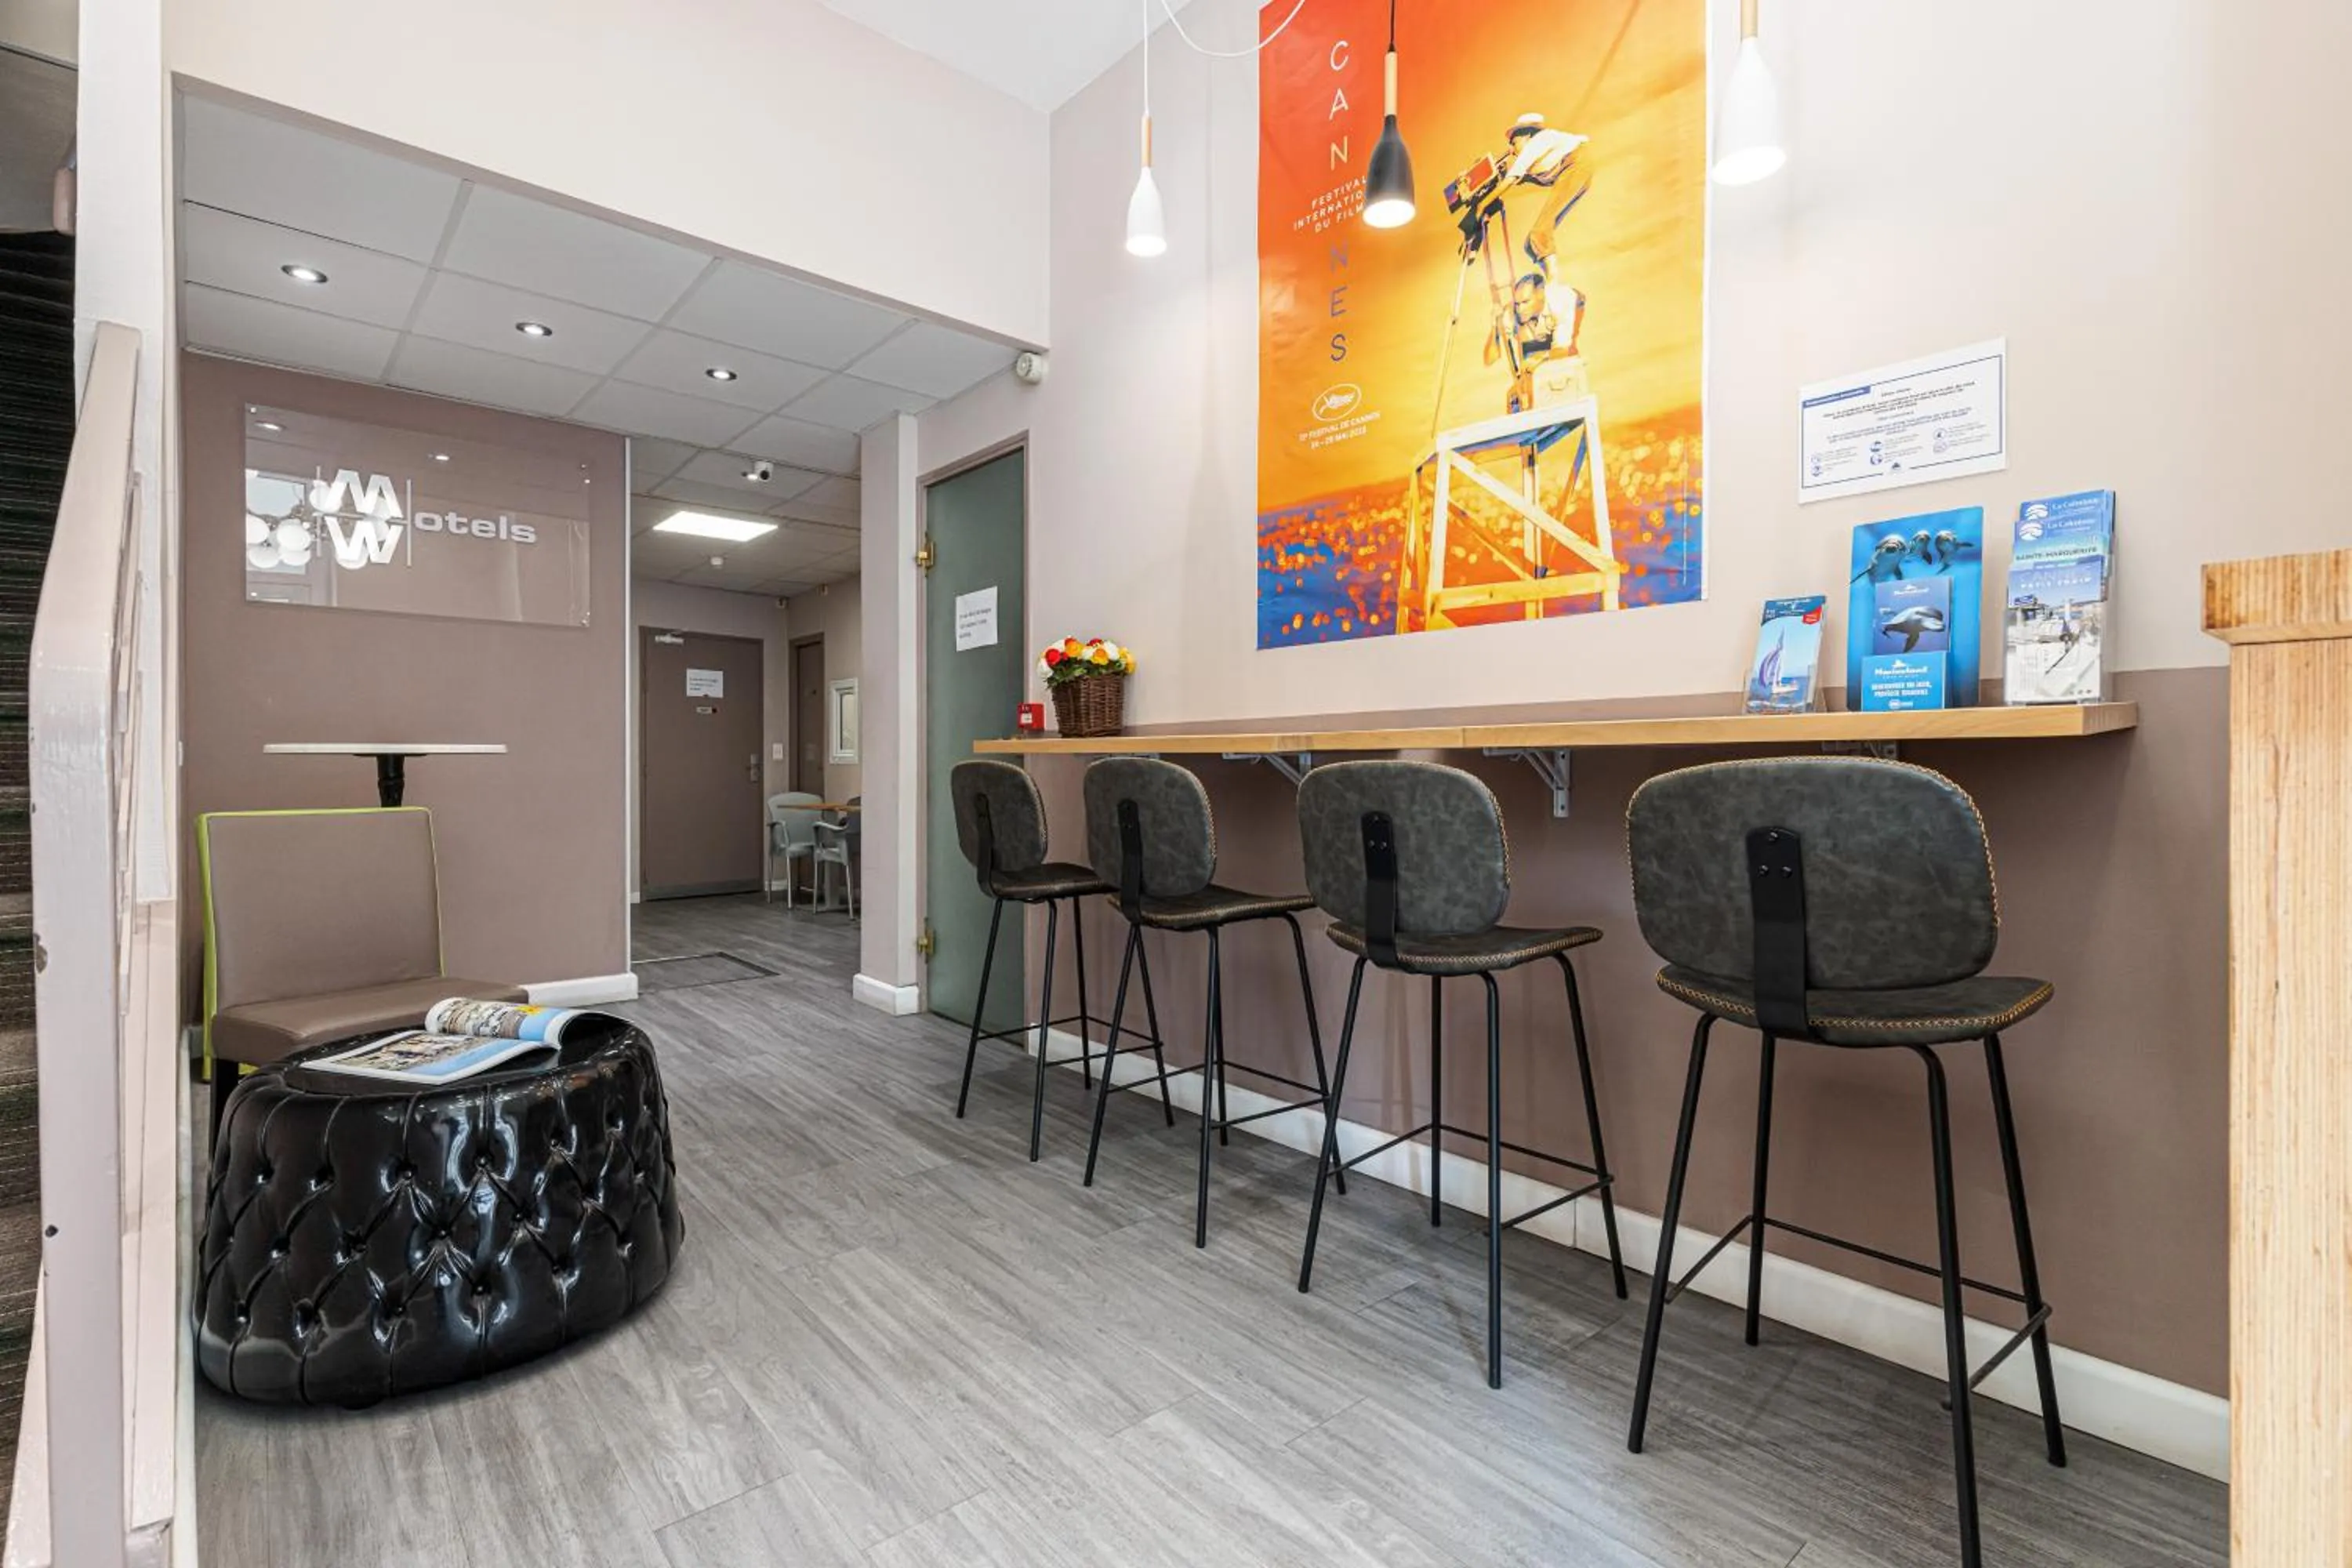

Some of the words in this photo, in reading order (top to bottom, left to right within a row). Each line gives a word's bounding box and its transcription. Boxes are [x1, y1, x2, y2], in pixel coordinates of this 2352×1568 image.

[1293, 190, 1363, 230] INTERNATIO
[1312, 175, 1366, 210] FESTIVAL
[1330, 40, 1349, 362] CANNES
[1315, 218, 1330, 233] DU
